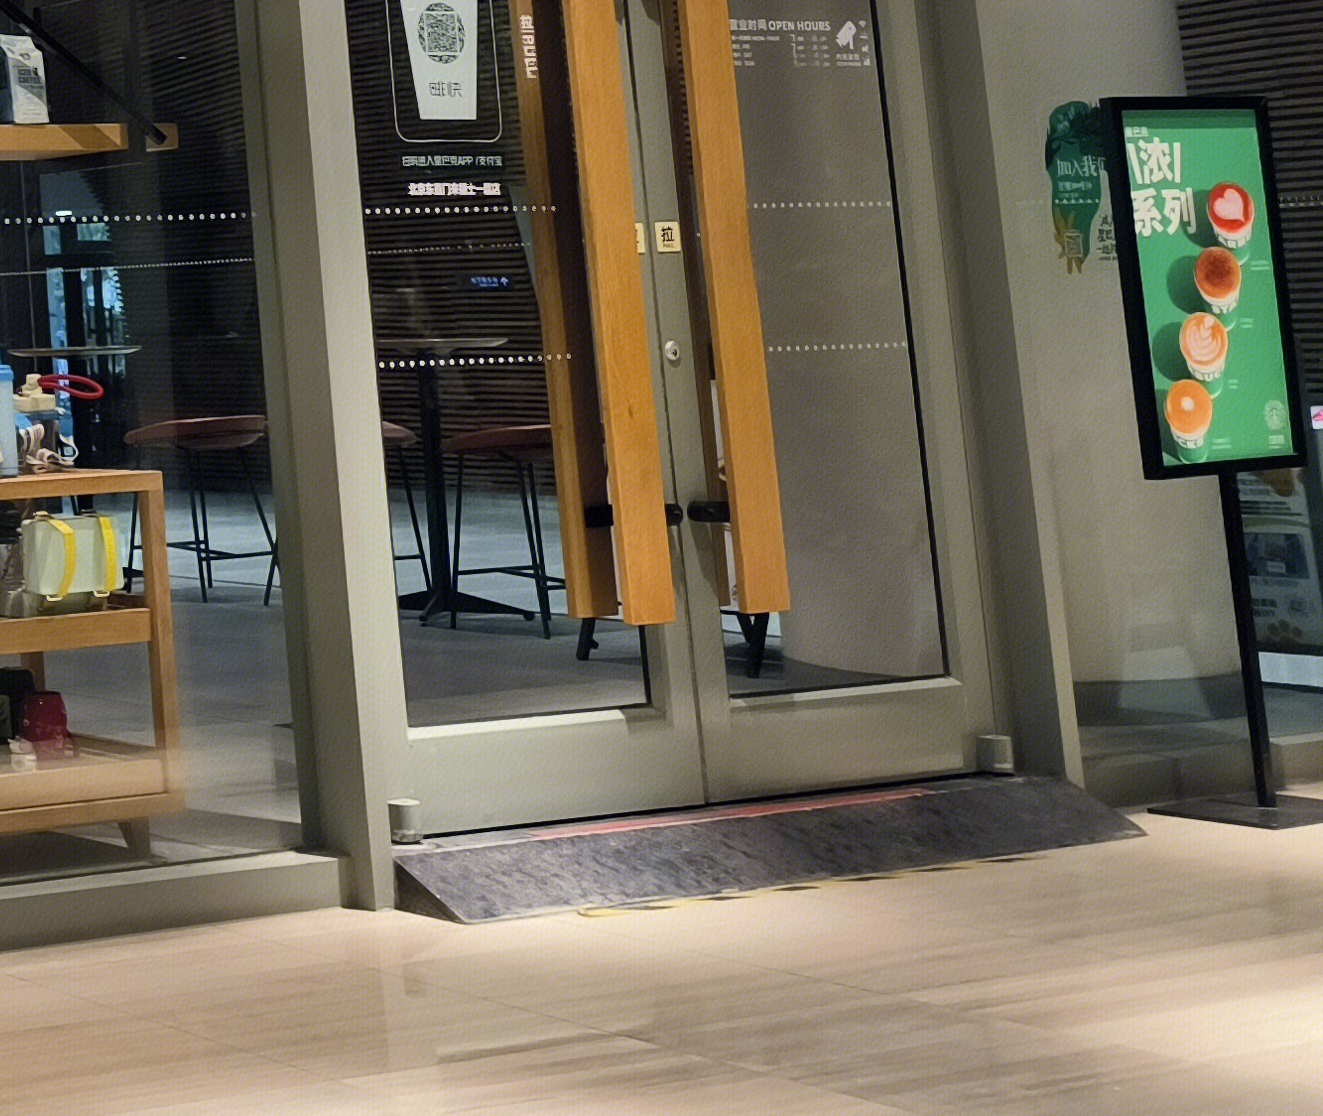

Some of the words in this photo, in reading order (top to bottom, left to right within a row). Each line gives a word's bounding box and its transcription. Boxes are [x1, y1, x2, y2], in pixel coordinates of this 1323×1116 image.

[768, 20, 795, 31] OPEN
[797, 21, 831, 31] HOURS
[1131, 187, 1197, 238] 系列
[661, 225, 674, 242] 拉
